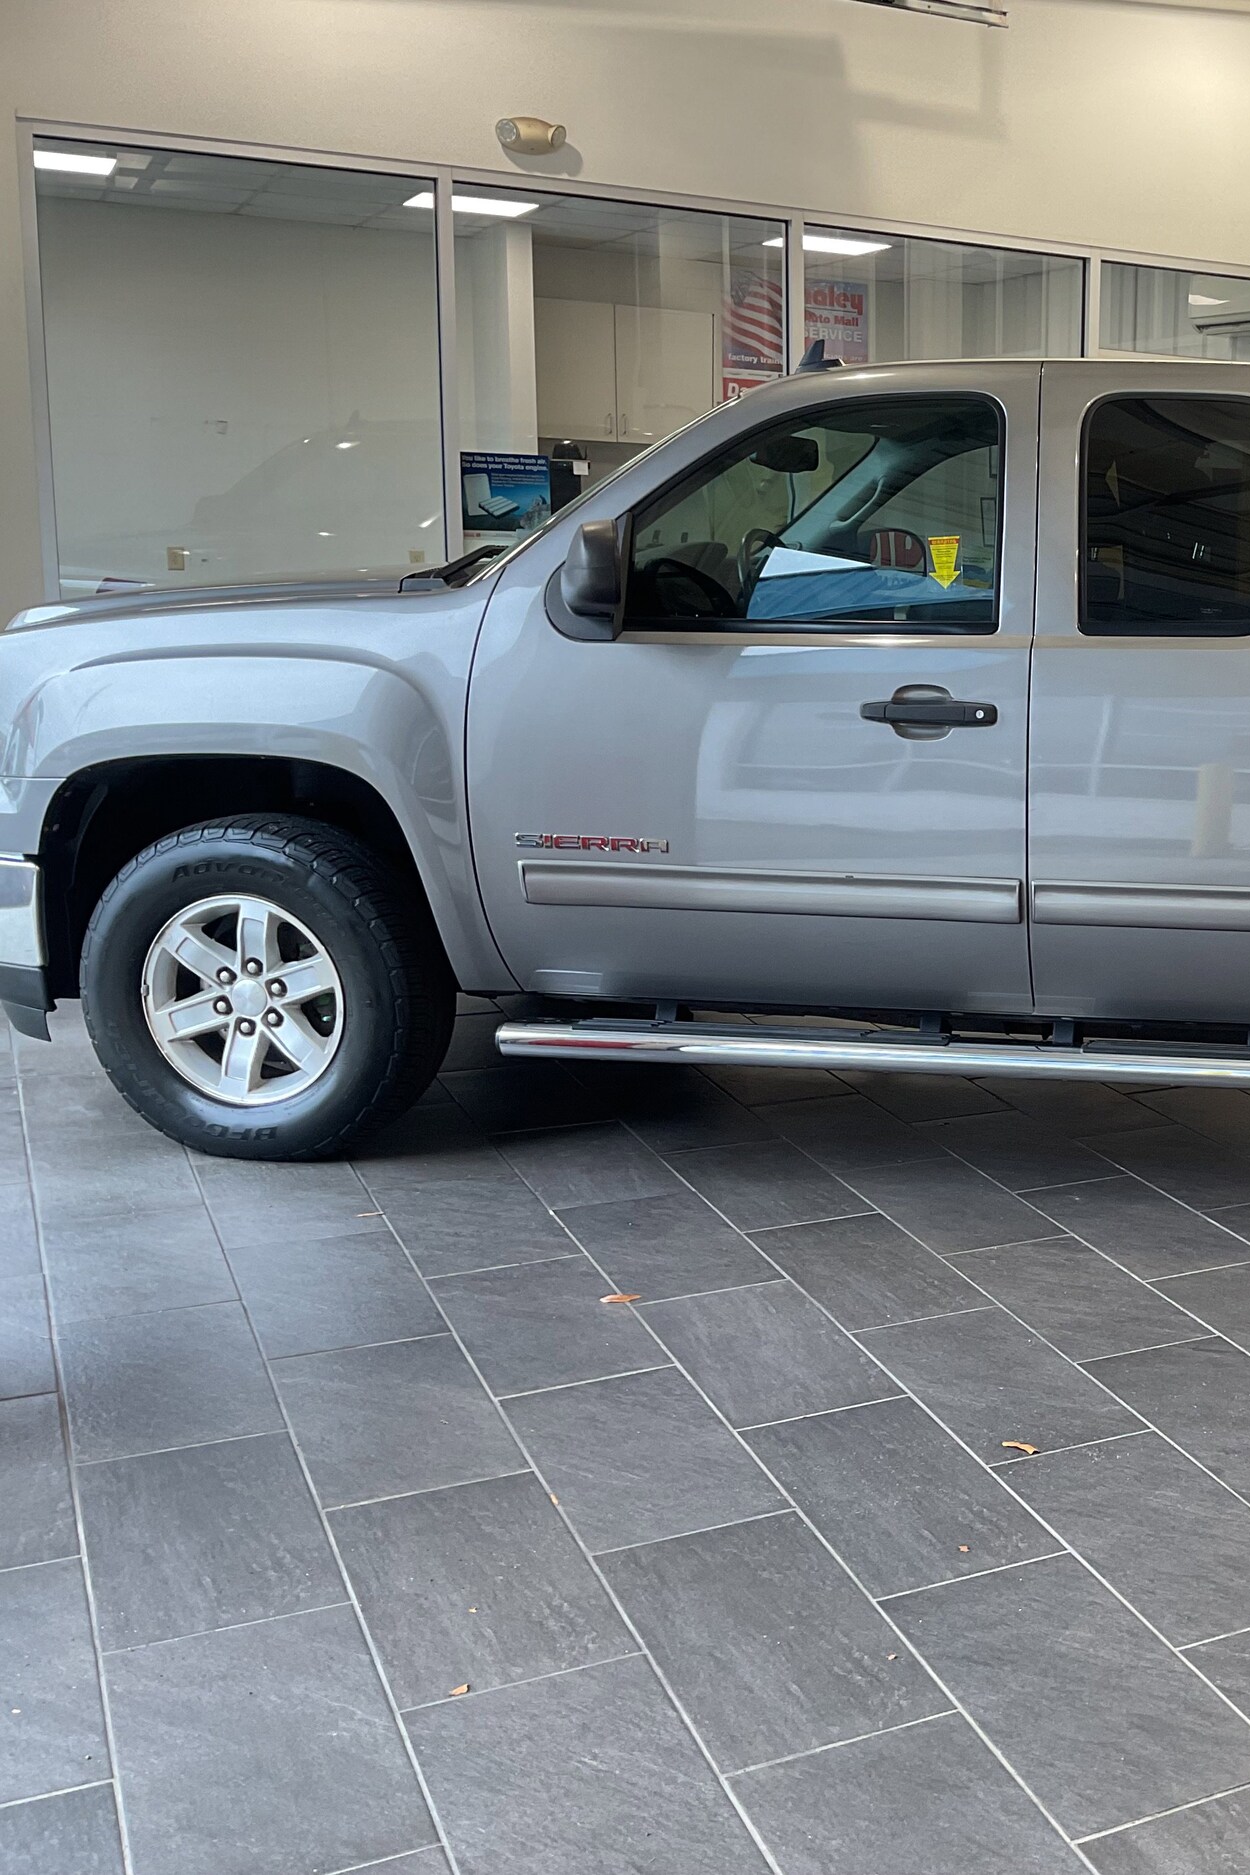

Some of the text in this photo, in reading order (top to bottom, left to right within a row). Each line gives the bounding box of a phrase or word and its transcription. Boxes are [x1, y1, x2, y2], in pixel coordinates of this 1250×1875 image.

[833, 315, 859, 327] Mall
[728, 352, 758, 364] factory
[514, 832, 669, 854] SIERRA
